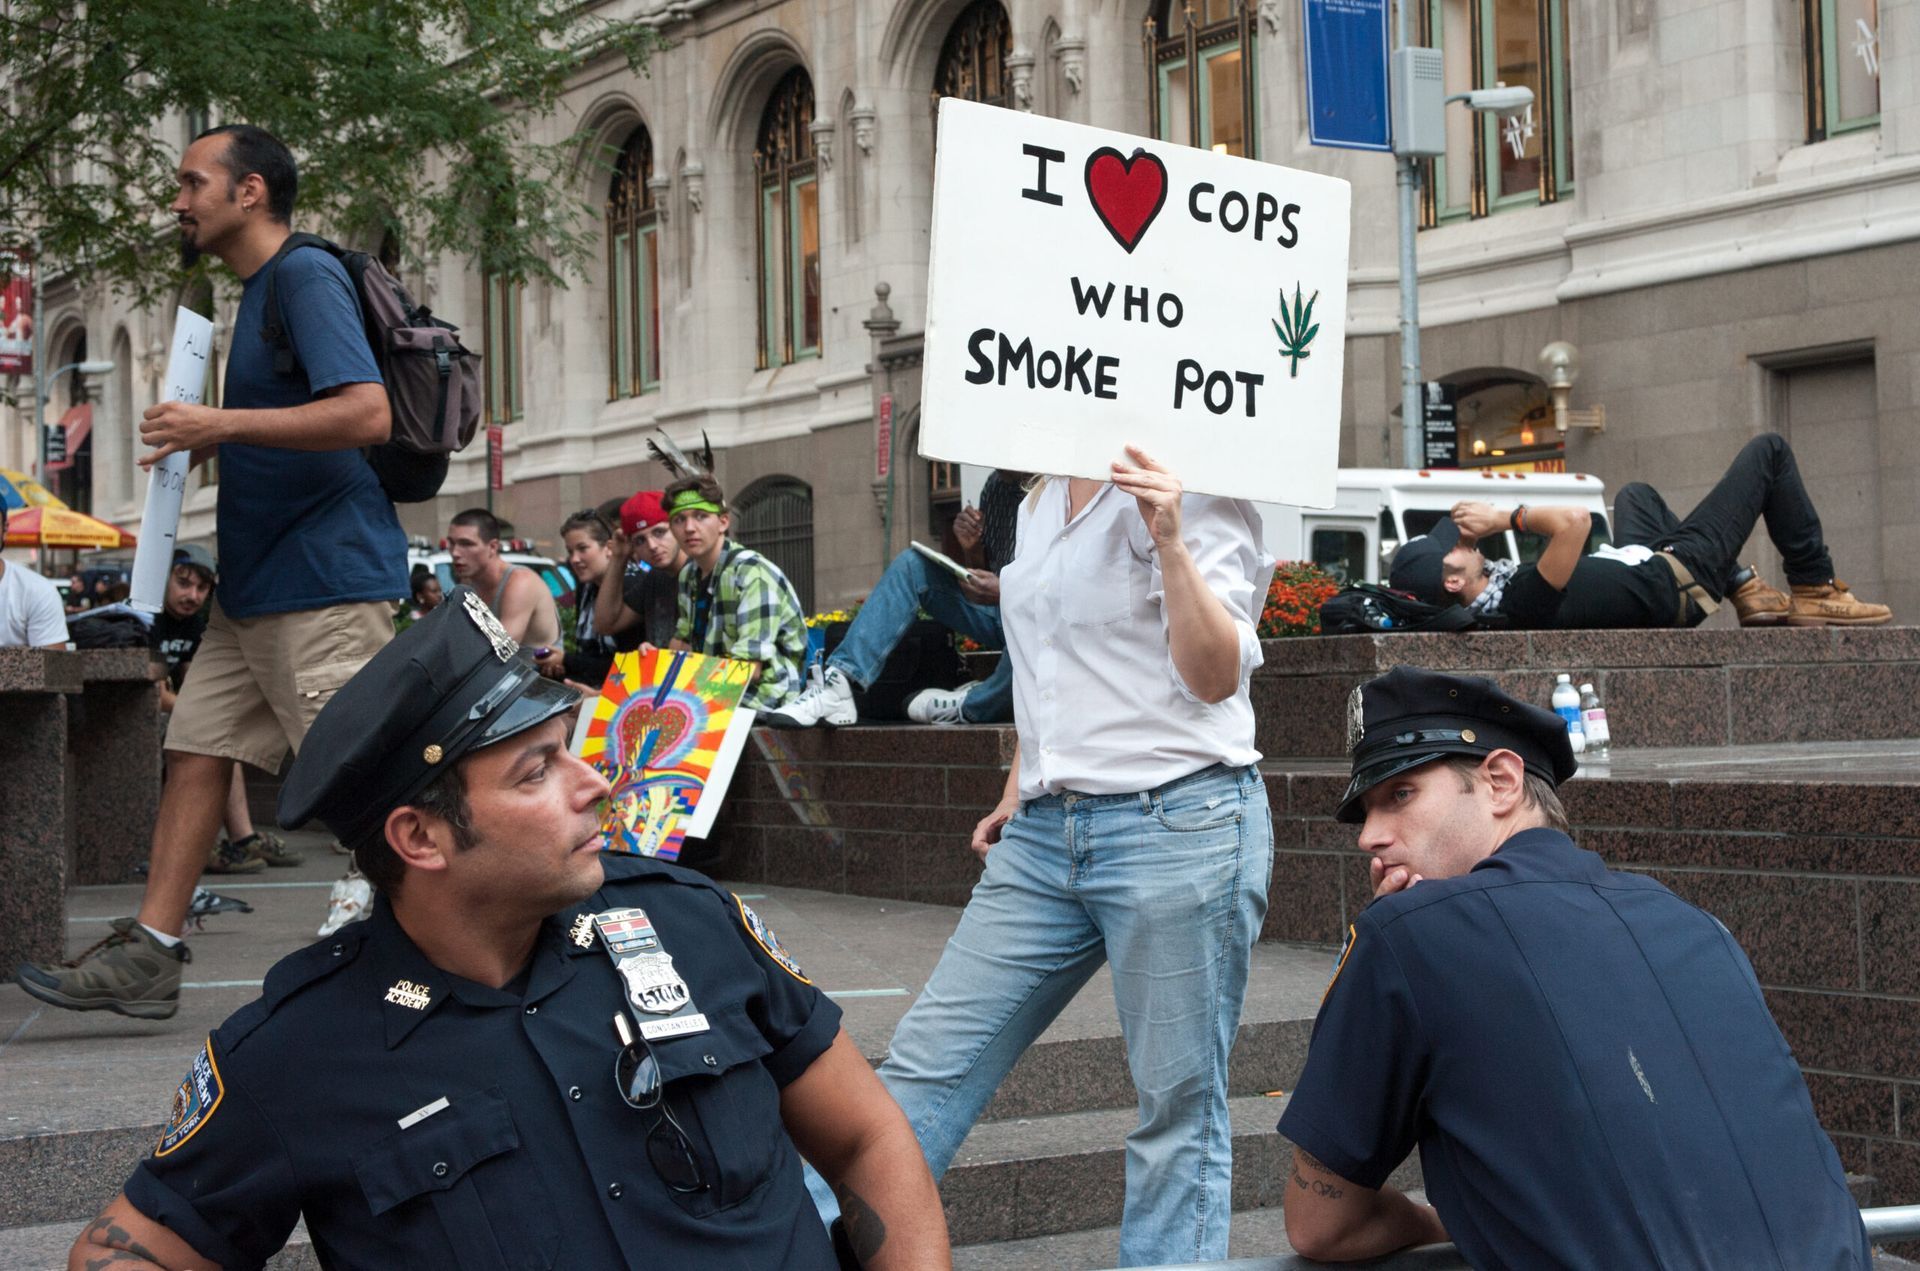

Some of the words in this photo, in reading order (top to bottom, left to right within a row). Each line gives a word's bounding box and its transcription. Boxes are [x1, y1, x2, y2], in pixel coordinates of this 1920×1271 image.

[1022, 144, 1065, 206] I
[1189, 183, 1300, 248] COPS
[1071, 277, 1183, 328] WHO
[182, 332, 206, 360] ALL
[965, 329, 1119, 399] SMOKE
[1174, 359, 1264, 417] POT
[384, 992, 430, 1011] ACADEMY
[395, 979, 430, 997] POLICE
[164, 1136, 178, 1149] NEW
[179, 1115, 201, 1139] YORK
